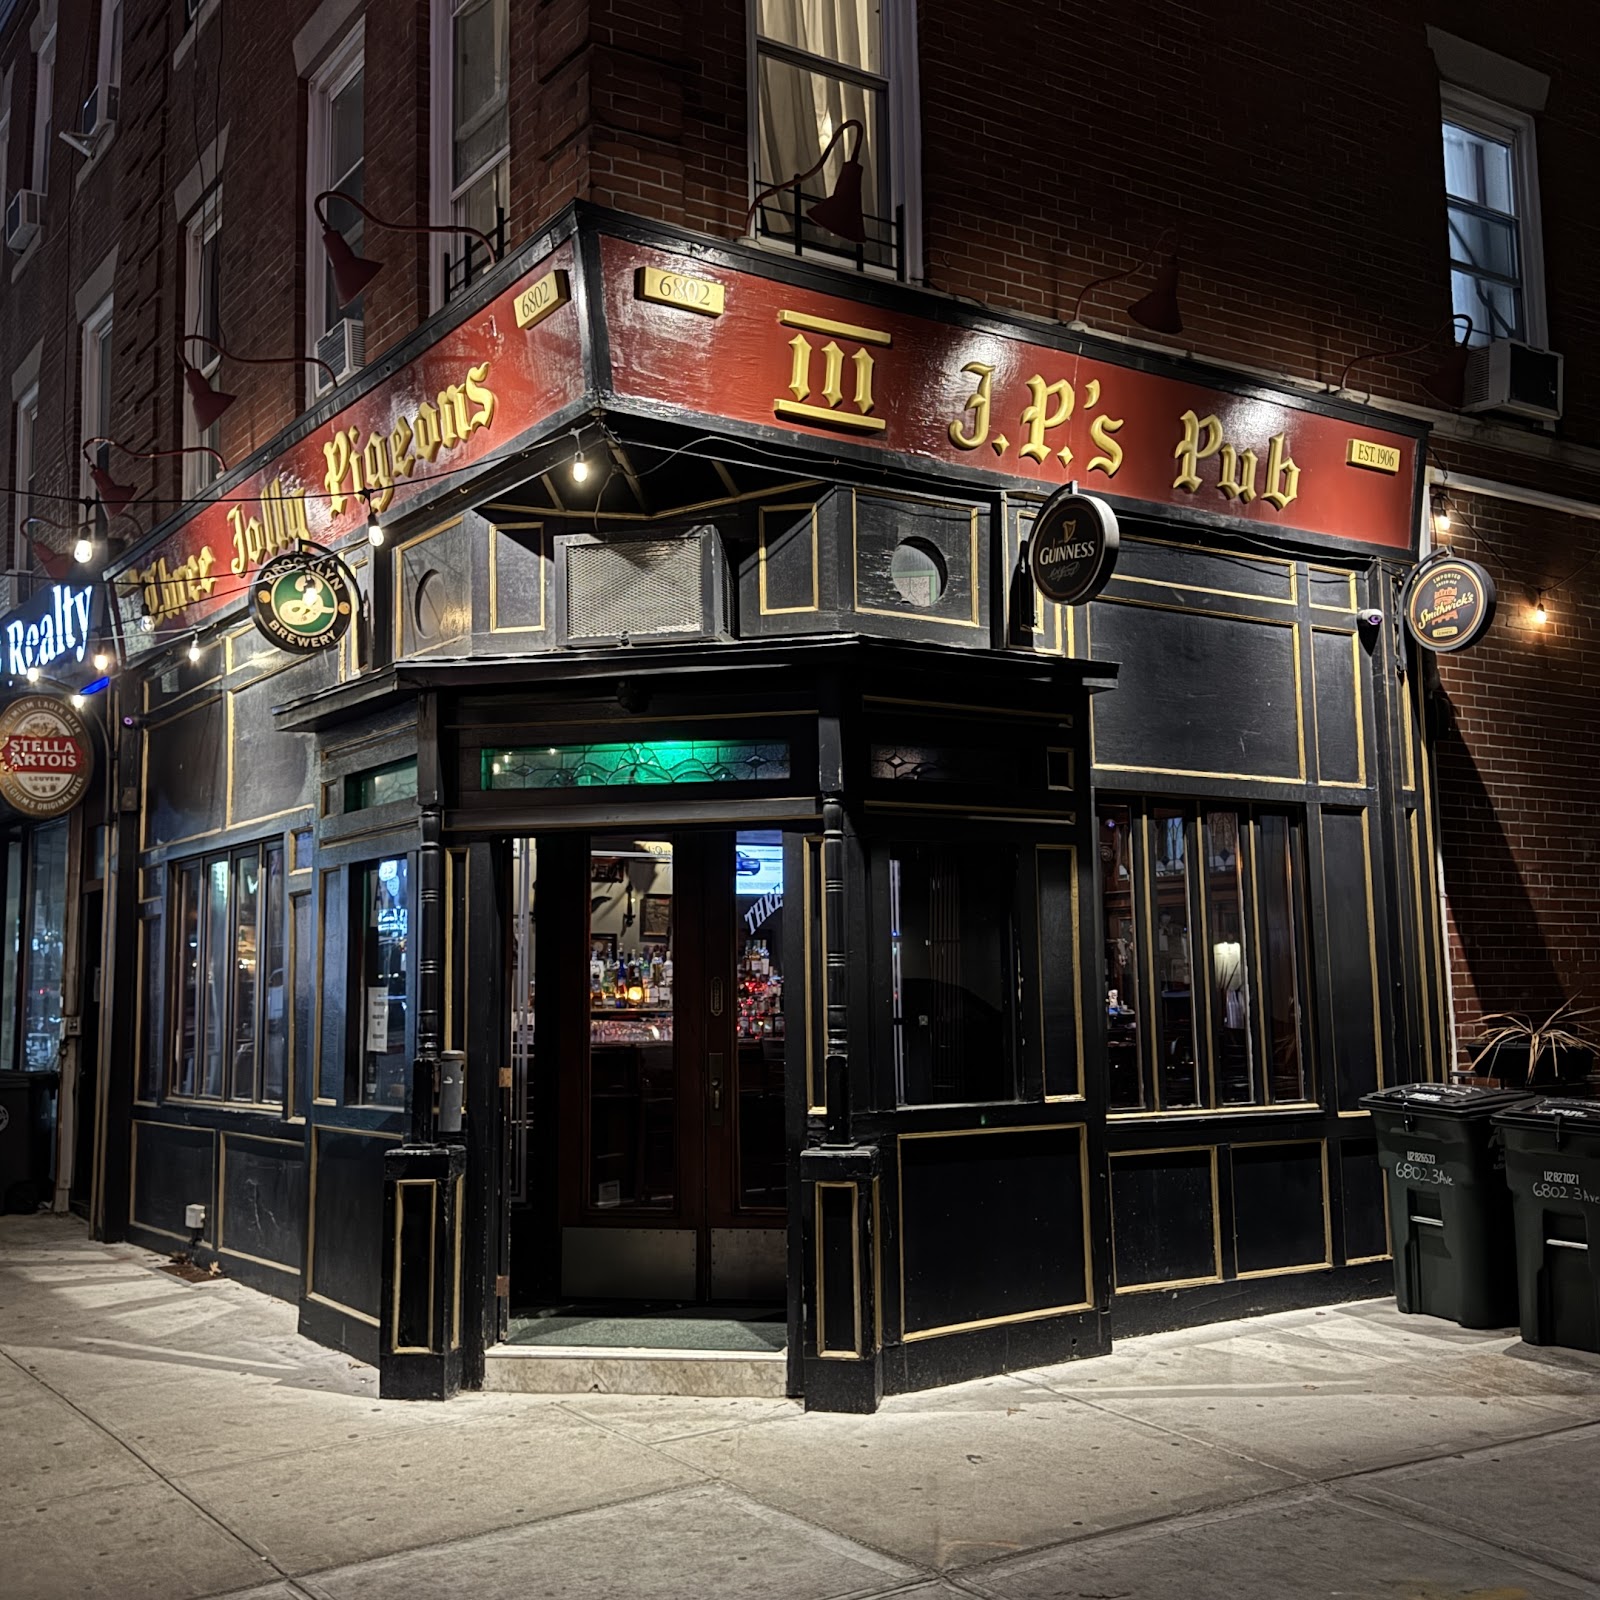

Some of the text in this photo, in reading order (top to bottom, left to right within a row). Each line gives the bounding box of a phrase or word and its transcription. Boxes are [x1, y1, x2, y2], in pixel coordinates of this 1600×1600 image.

[522, 281, 550, 318] 6802
[659, 275, 710, 306] 6802
[949, 361, 1301, 511] J.P.'s Pub
[227, 477, 311, 578] Jolly
[323, 361, 495, 519] Pigeons
[1358, 443, 1395, 467] EST. 1906
[1040, 541, 1095, 565] GUINNESS
[263, 556, 343, 591] BROOLYN
[1433, 573, 1461, 584] IMPORTED
[1419, 591, 1474, 630] Smithwick's
[7, 584, 93, 675] Realty
[269, 619, 337, 648] BREWERY
[10, 740, 75, 754] STELLA
[10, 753, 77, 768] ARTOIS
[1396, 1162, 1430, 1182] 6802
[1532, 1182, 1569, 1199] 6802
